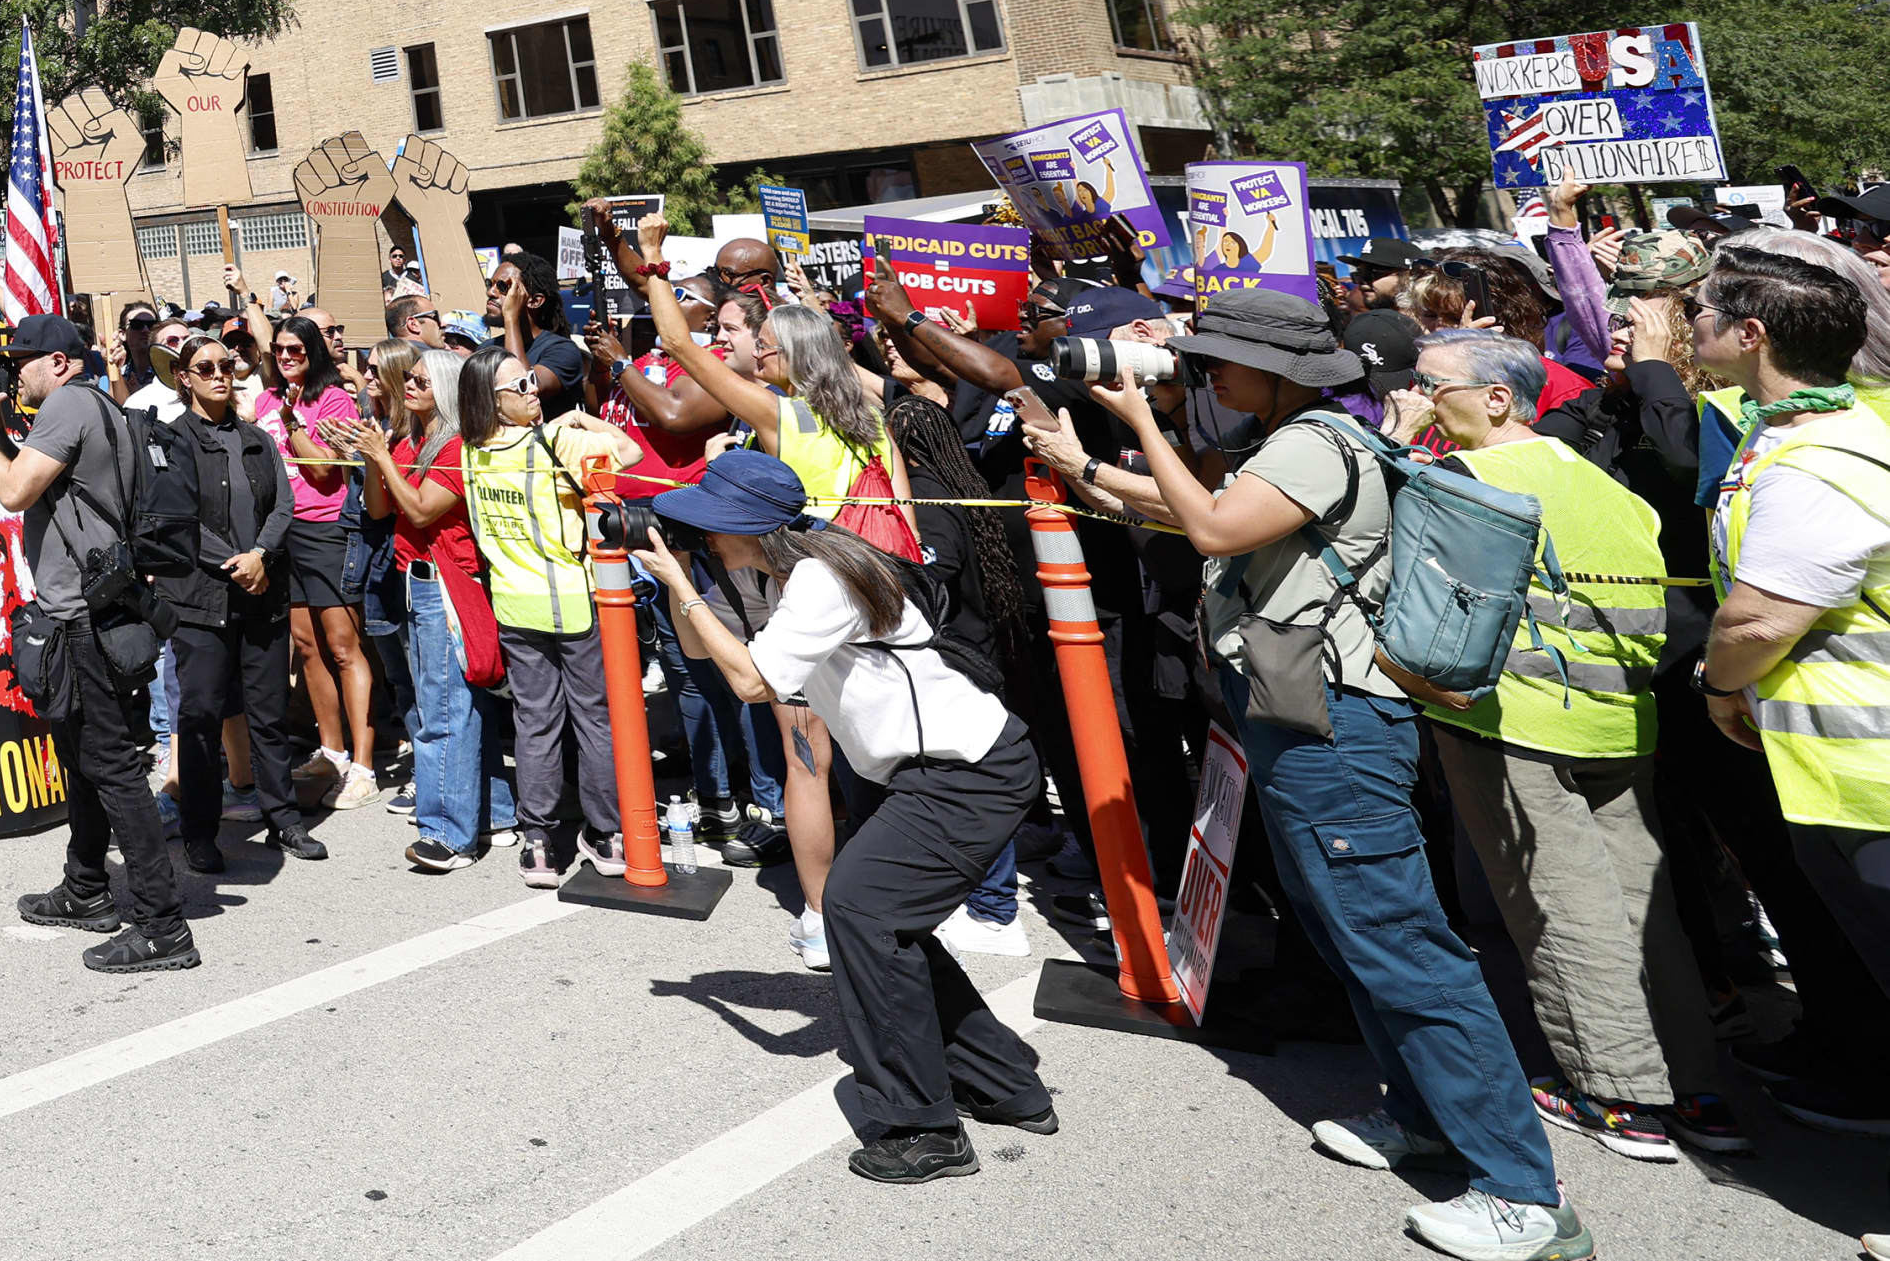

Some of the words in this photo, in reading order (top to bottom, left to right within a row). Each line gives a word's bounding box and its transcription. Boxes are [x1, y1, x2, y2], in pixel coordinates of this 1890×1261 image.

[1569, 33, 1703, 90] USA
[187, 95, 222, 112] OUR
[1545, 102, 1614, 137] OVER
[1073, 121, 1103, 145] PROTECT
[1083, 141, 1116, 162] WORKERS
[1086, 137, 1101, 149] VA
[53, 161, 123, 181] PROTECT
[1046, 161, 1059, 170] ARE
[1235, 174, 1275, 191] PROTECT
[1191, 191, 1225, 204] MIGRANTS
[1249, 188, 1271, 200] VA
[306, 199, 381, 217] CONSTITUTION
[1198, 202, 1210, 211] ARE
[1244, 195, 1288, 213] WORKERS
[1071, 219, 1106, 237] BAC
[1311, 209, 1346, 239] OCAL
[1342, 209, 1370, 237] 705
[969, 242, 1028, 261] CUTS
[898, 271, 935, 290] JOB
[937, 275, 996, 295] CUTS
[1196, 275, 1262, 291] BACK
[477, 486, 525, 506] OLUNTEER
[1180, 847, 1223, 949] OVER
